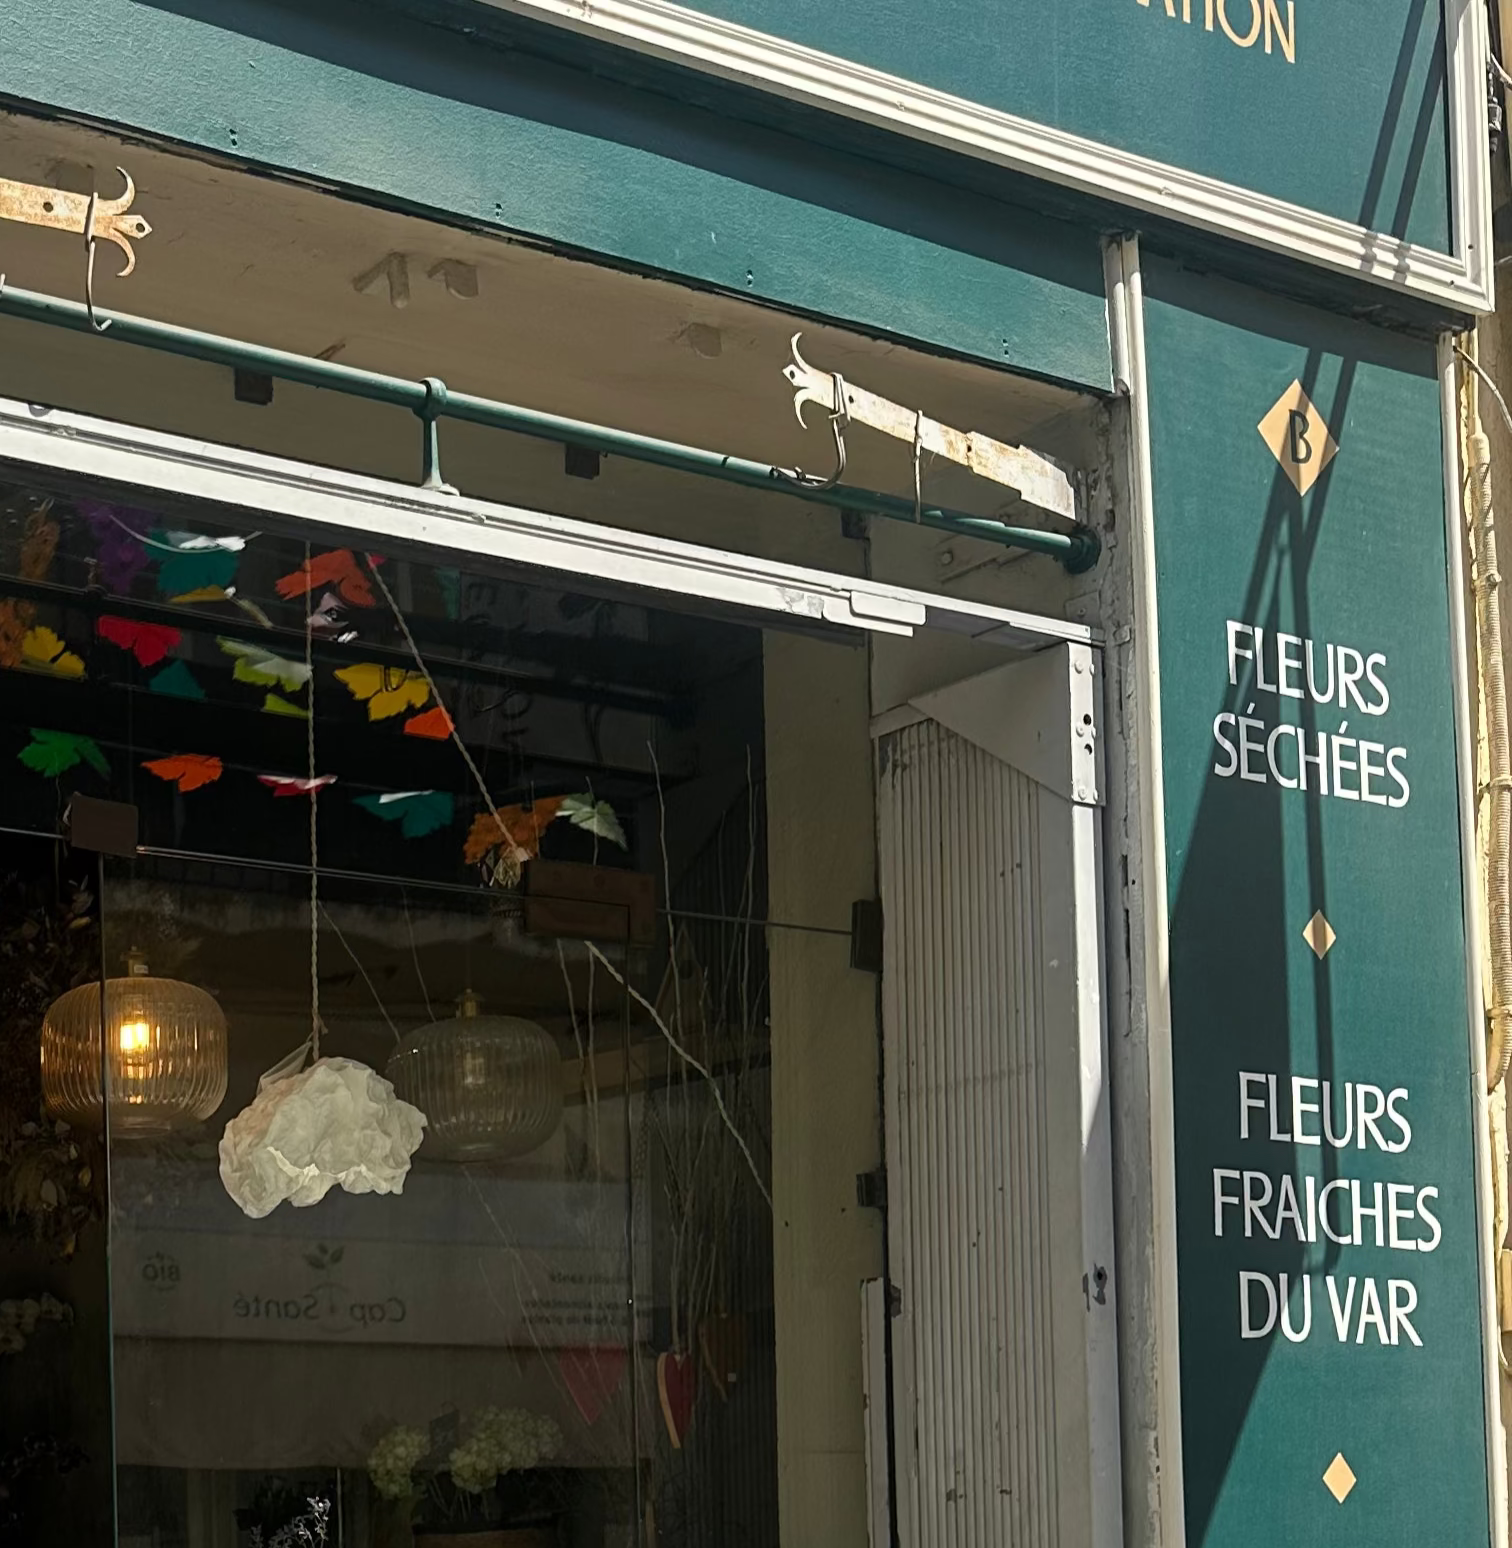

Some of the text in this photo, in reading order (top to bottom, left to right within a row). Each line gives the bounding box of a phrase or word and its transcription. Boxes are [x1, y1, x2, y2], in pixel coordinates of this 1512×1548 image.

[1289, 409, 1312, 463] B
[1226, 620, 1388, 716] FLEURS
[1214, 702, 1410, 806] SÉCHÉES
[1240, 1072, 1410, 1152] FLEURS
[1213, 1168, 1442, 1250] FRAICHES
[1239, 1271, 1423, 1347] DU VAR
